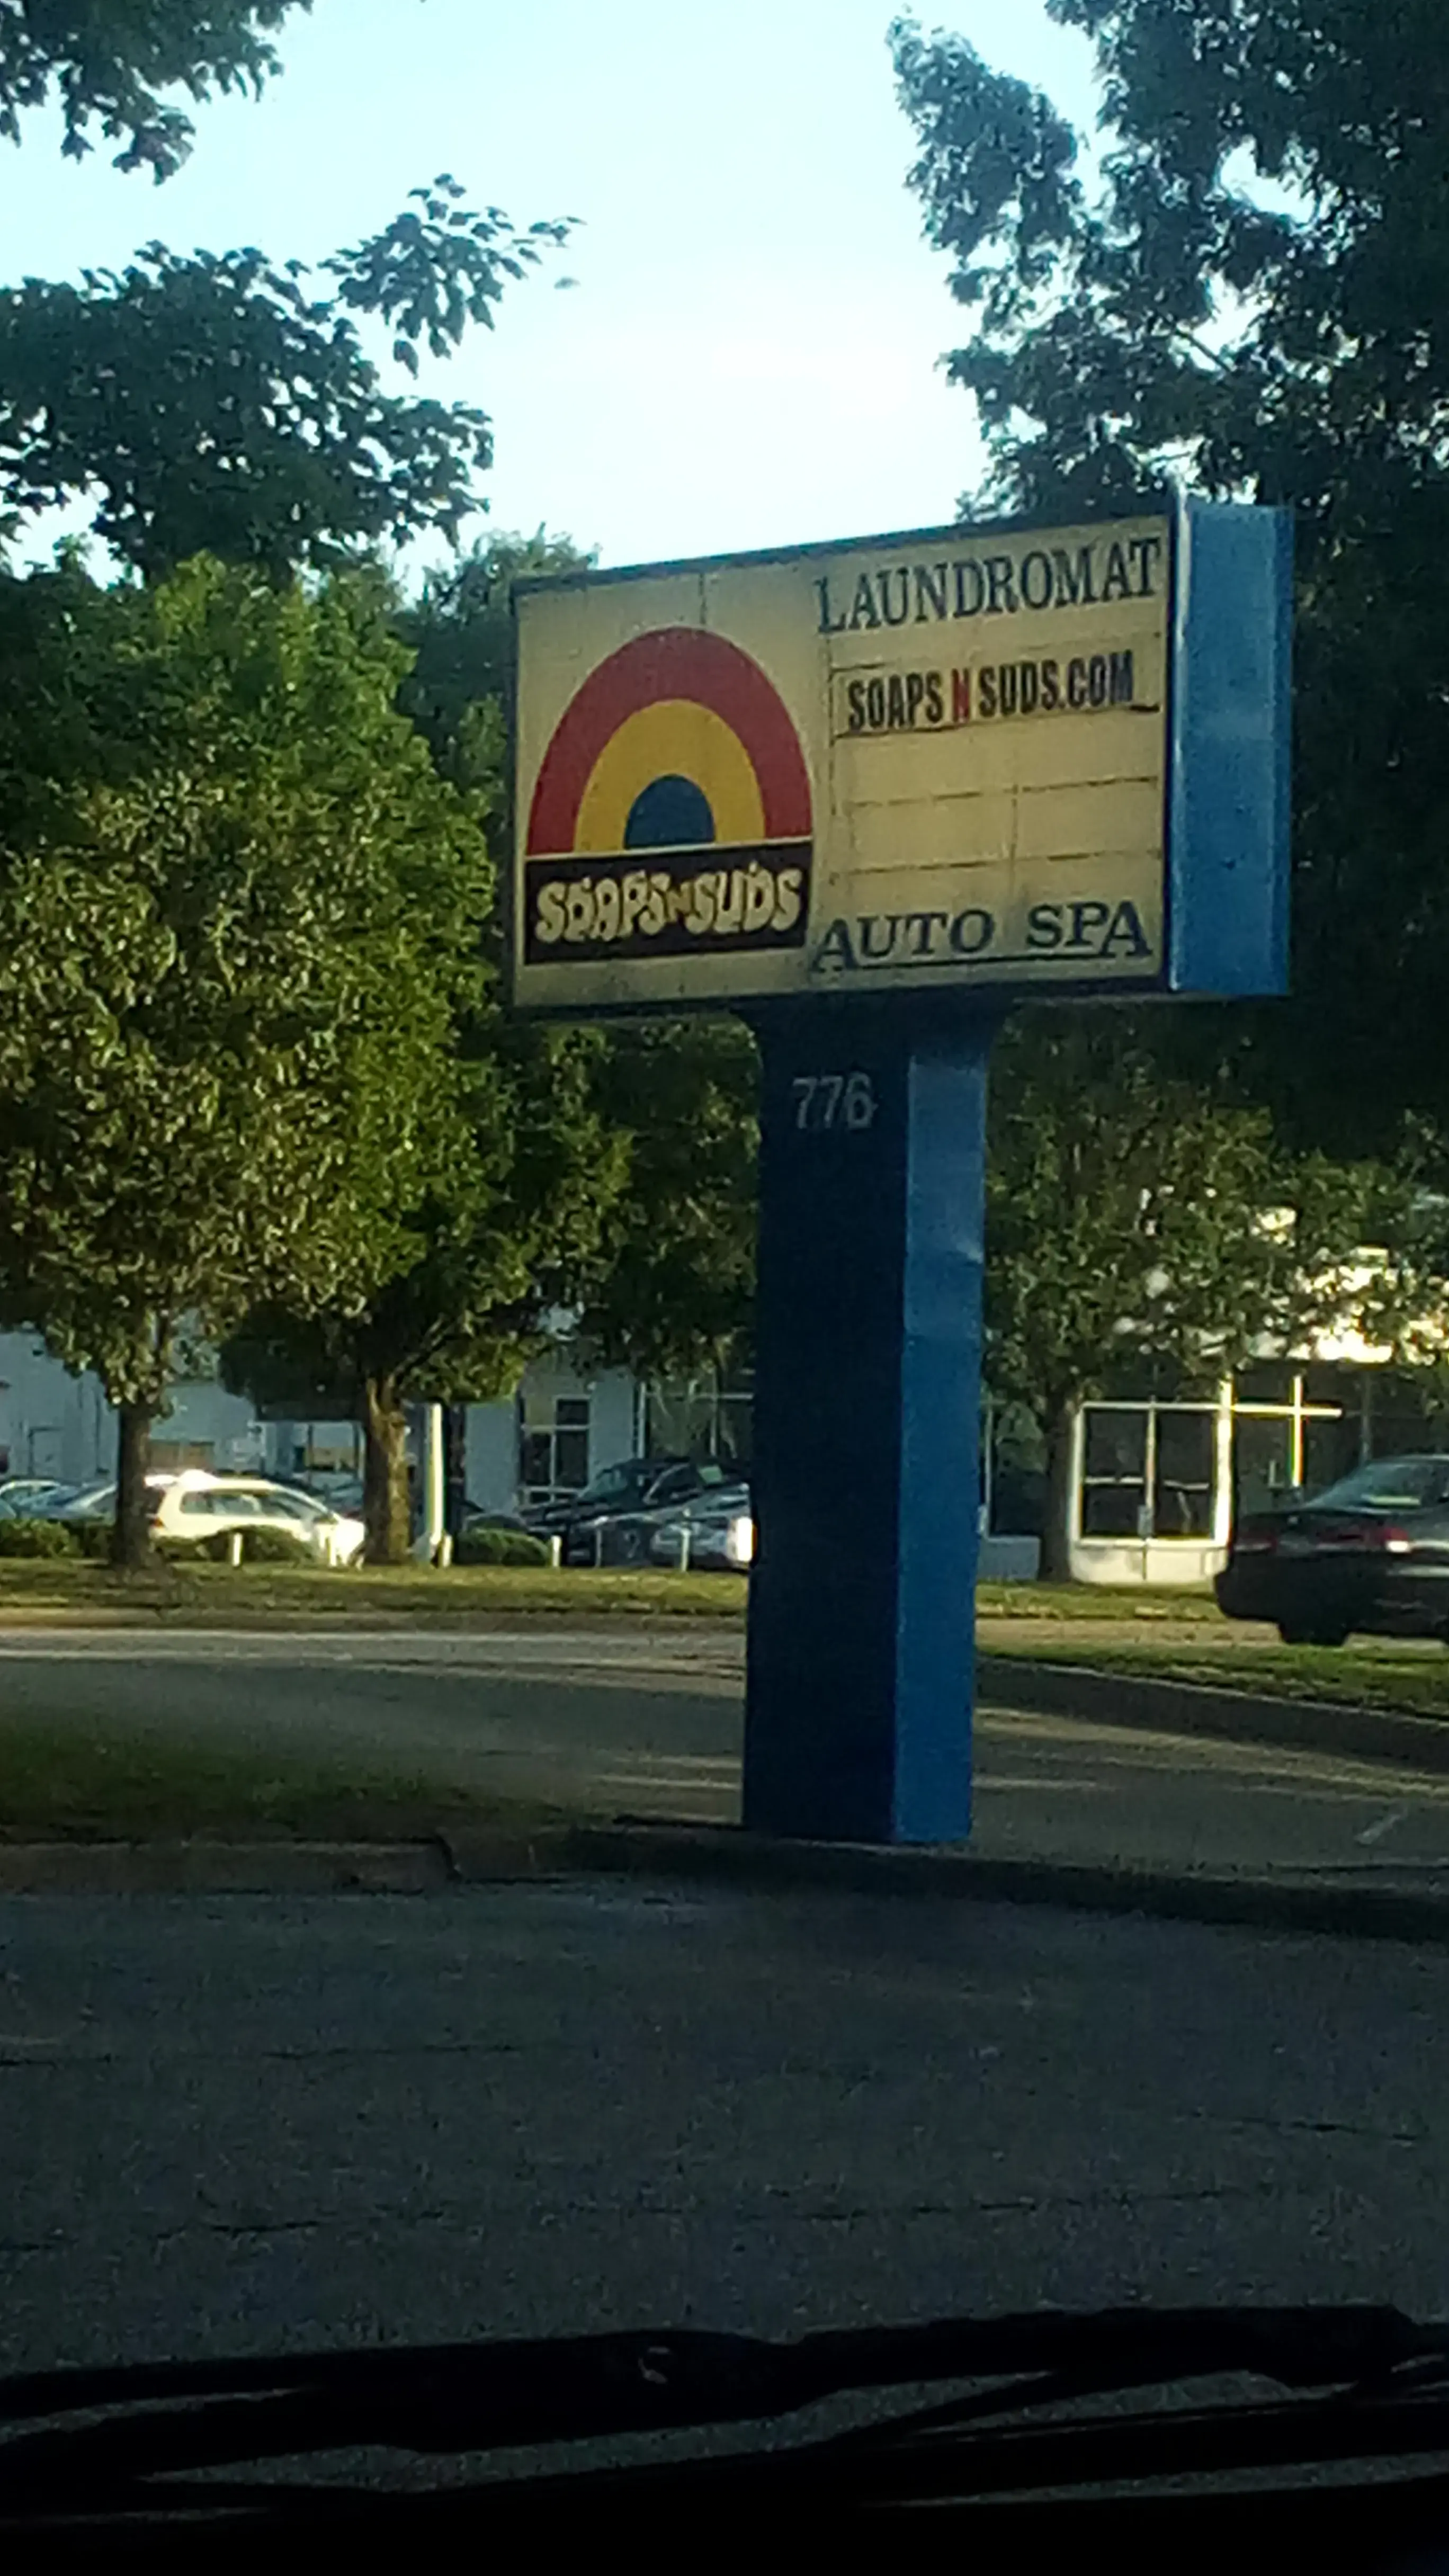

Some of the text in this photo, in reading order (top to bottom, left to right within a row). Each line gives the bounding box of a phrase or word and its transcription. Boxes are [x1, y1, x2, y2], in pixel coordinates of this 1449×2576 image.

[815, 536, 1162, 633] LAUNDROMAT
[811, 900, 1153, 973] AUTO SPA
[793, 1071, 878, 1130] 776
